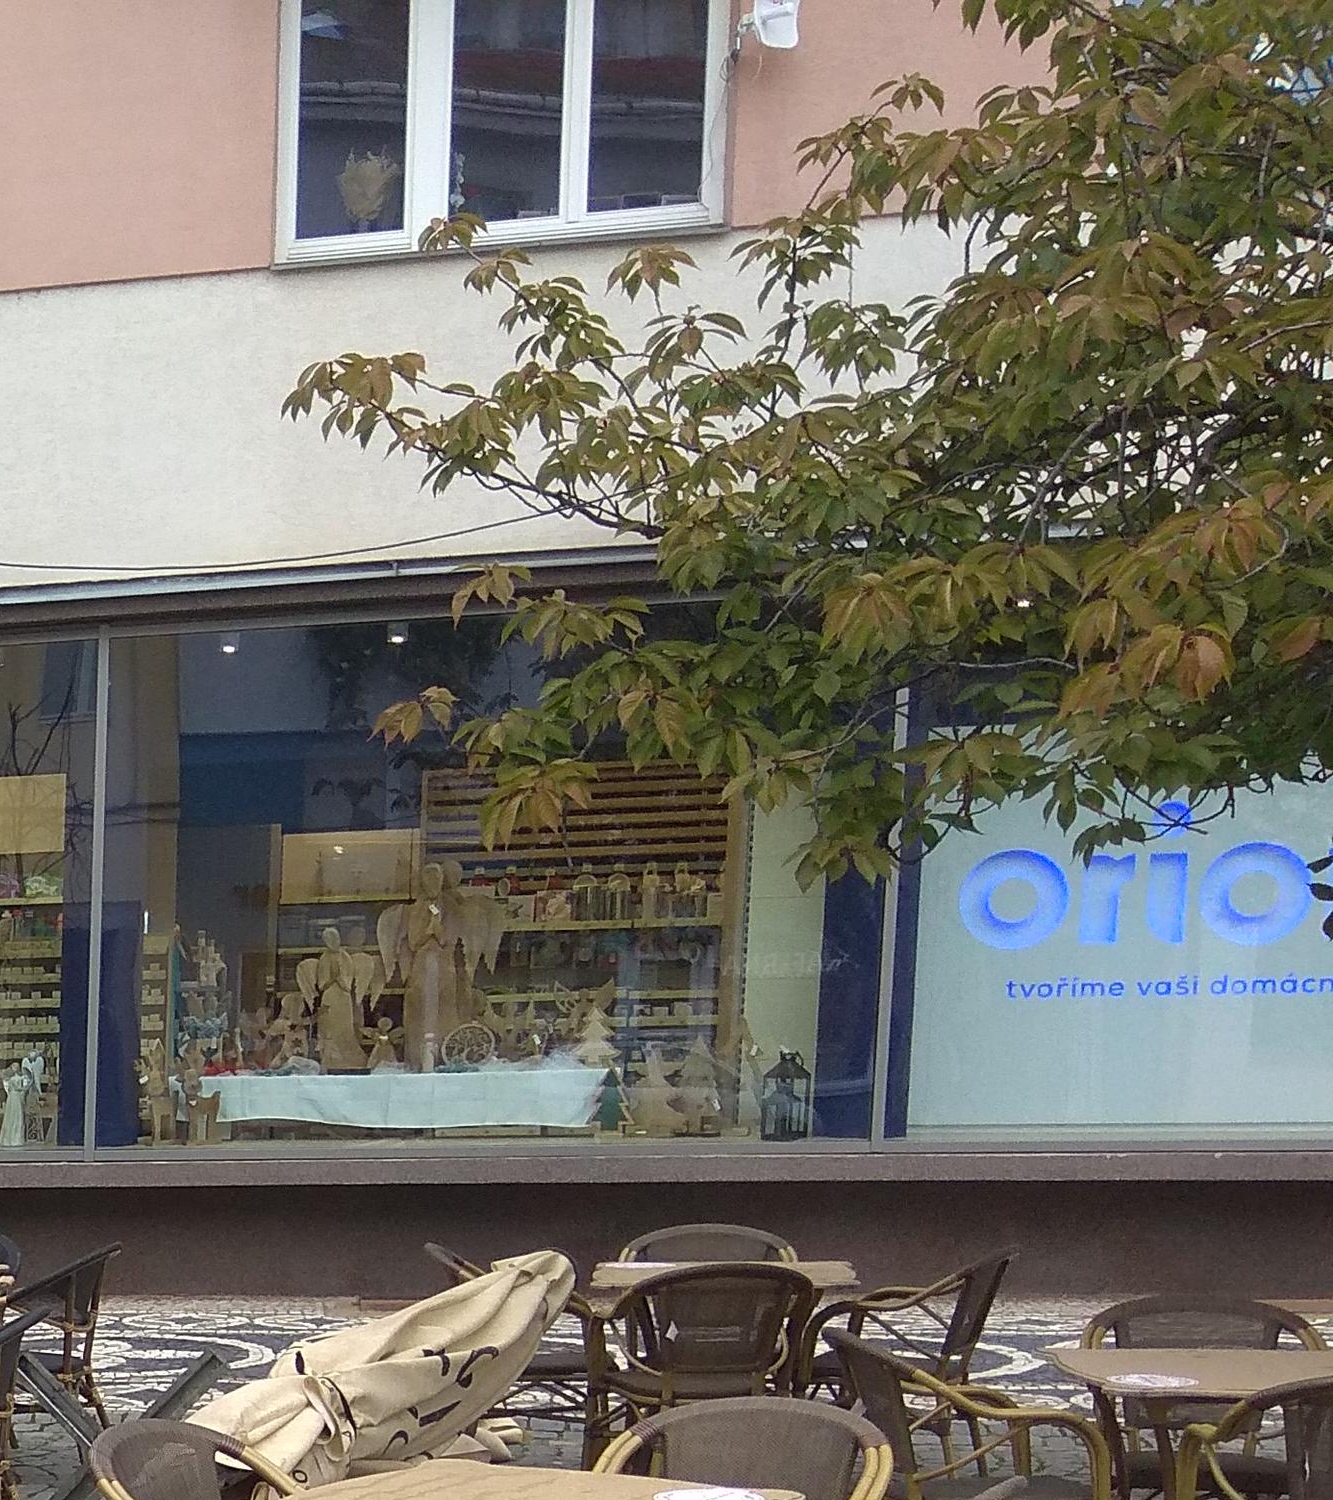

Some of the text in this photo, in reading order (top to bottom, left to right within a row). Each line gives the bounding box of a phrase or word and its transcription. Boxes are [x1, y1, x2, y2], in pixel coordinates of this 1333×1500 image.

[958, 799, 1333, 951] orio
[1005, 976, 1126, 999] tvoříme
[1136, 973, 1200, 997] vaši
